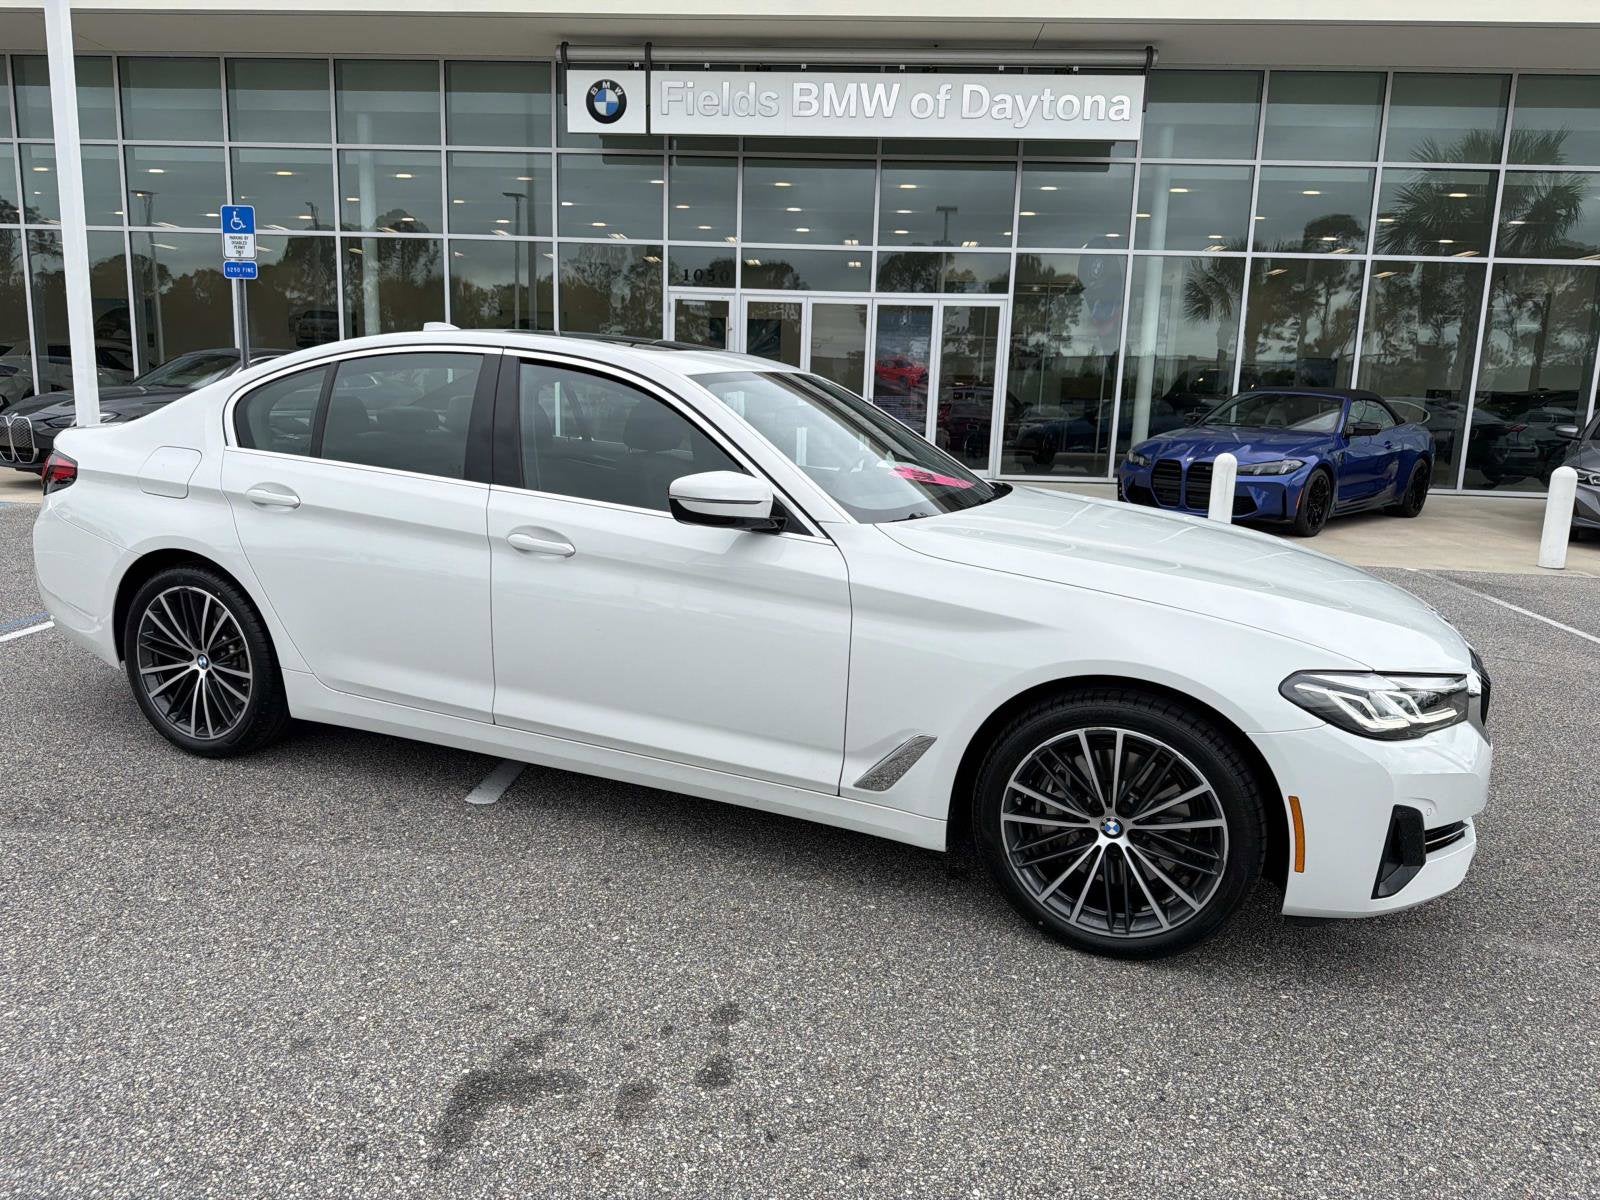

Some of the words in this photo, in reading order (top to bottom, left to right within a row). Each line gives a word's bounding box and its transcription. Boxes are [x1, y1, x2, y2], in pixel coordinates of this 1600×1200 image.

[590, 81, 623, 96] BMW
[660, 80, 780, 118] Fields
[792, 82, 901, 118] BMW
[910, 83, 952, 119] of
[961, 84, 1131, 129] Daytona
[683, 268, 730, 281] 1050
